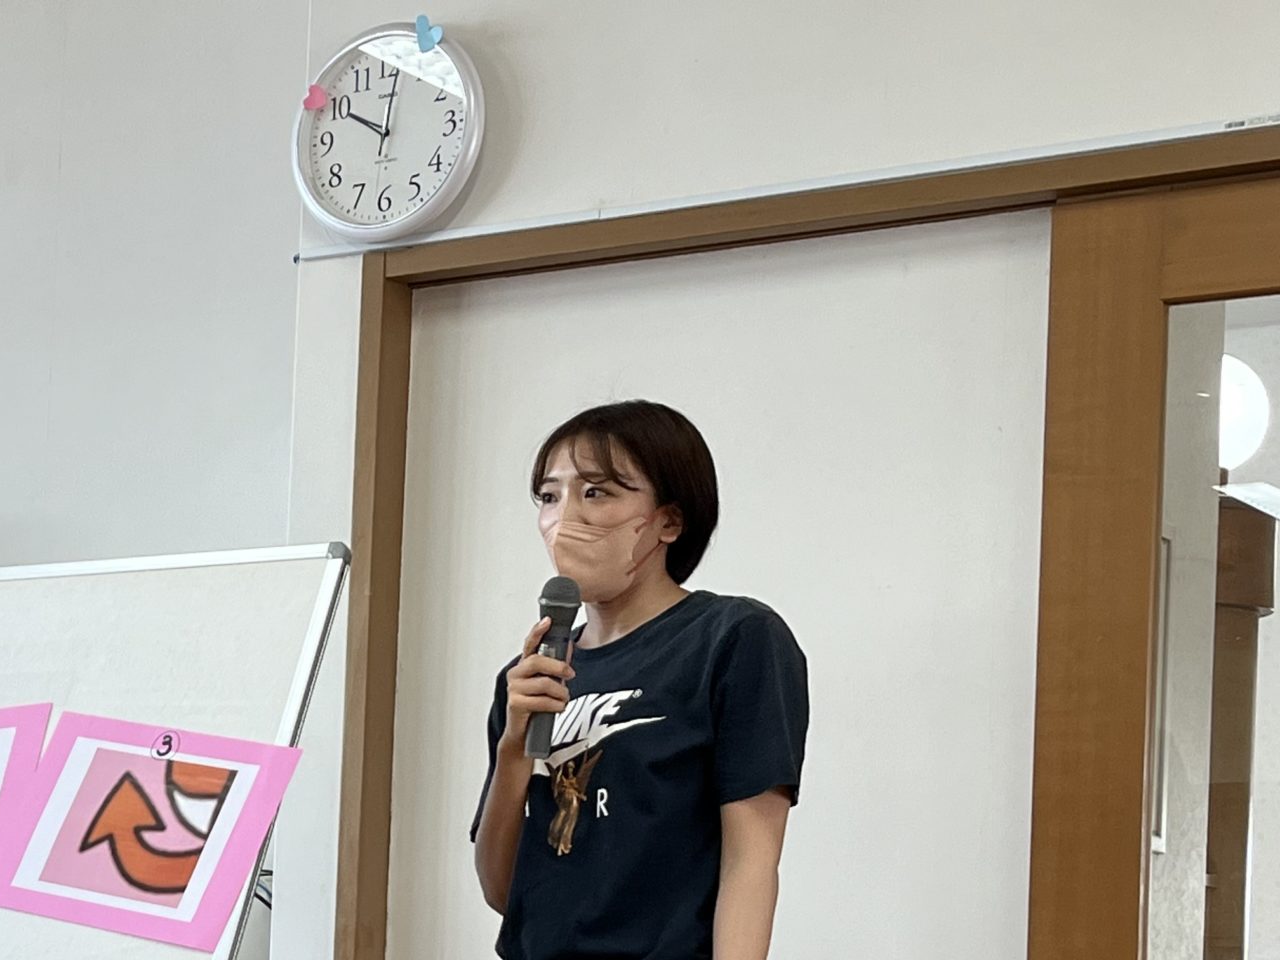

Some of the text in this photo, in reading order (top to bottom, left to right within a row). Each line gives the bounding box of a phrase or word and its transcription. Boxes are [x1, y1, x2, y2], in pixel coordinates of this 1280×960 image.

[353, 66, 371, 93] 11
[330, 94, 352, 121] 10
[442, 109, 456, 138] 3
[320, 130, 335, 158] 9
[427, 144, 442, 173] 4
[328, 162, 343, 188] 8
[408, 172, 421, 202] 5
[351, 182, 366, 210] 7
[377, 184, 392, 213] 6
